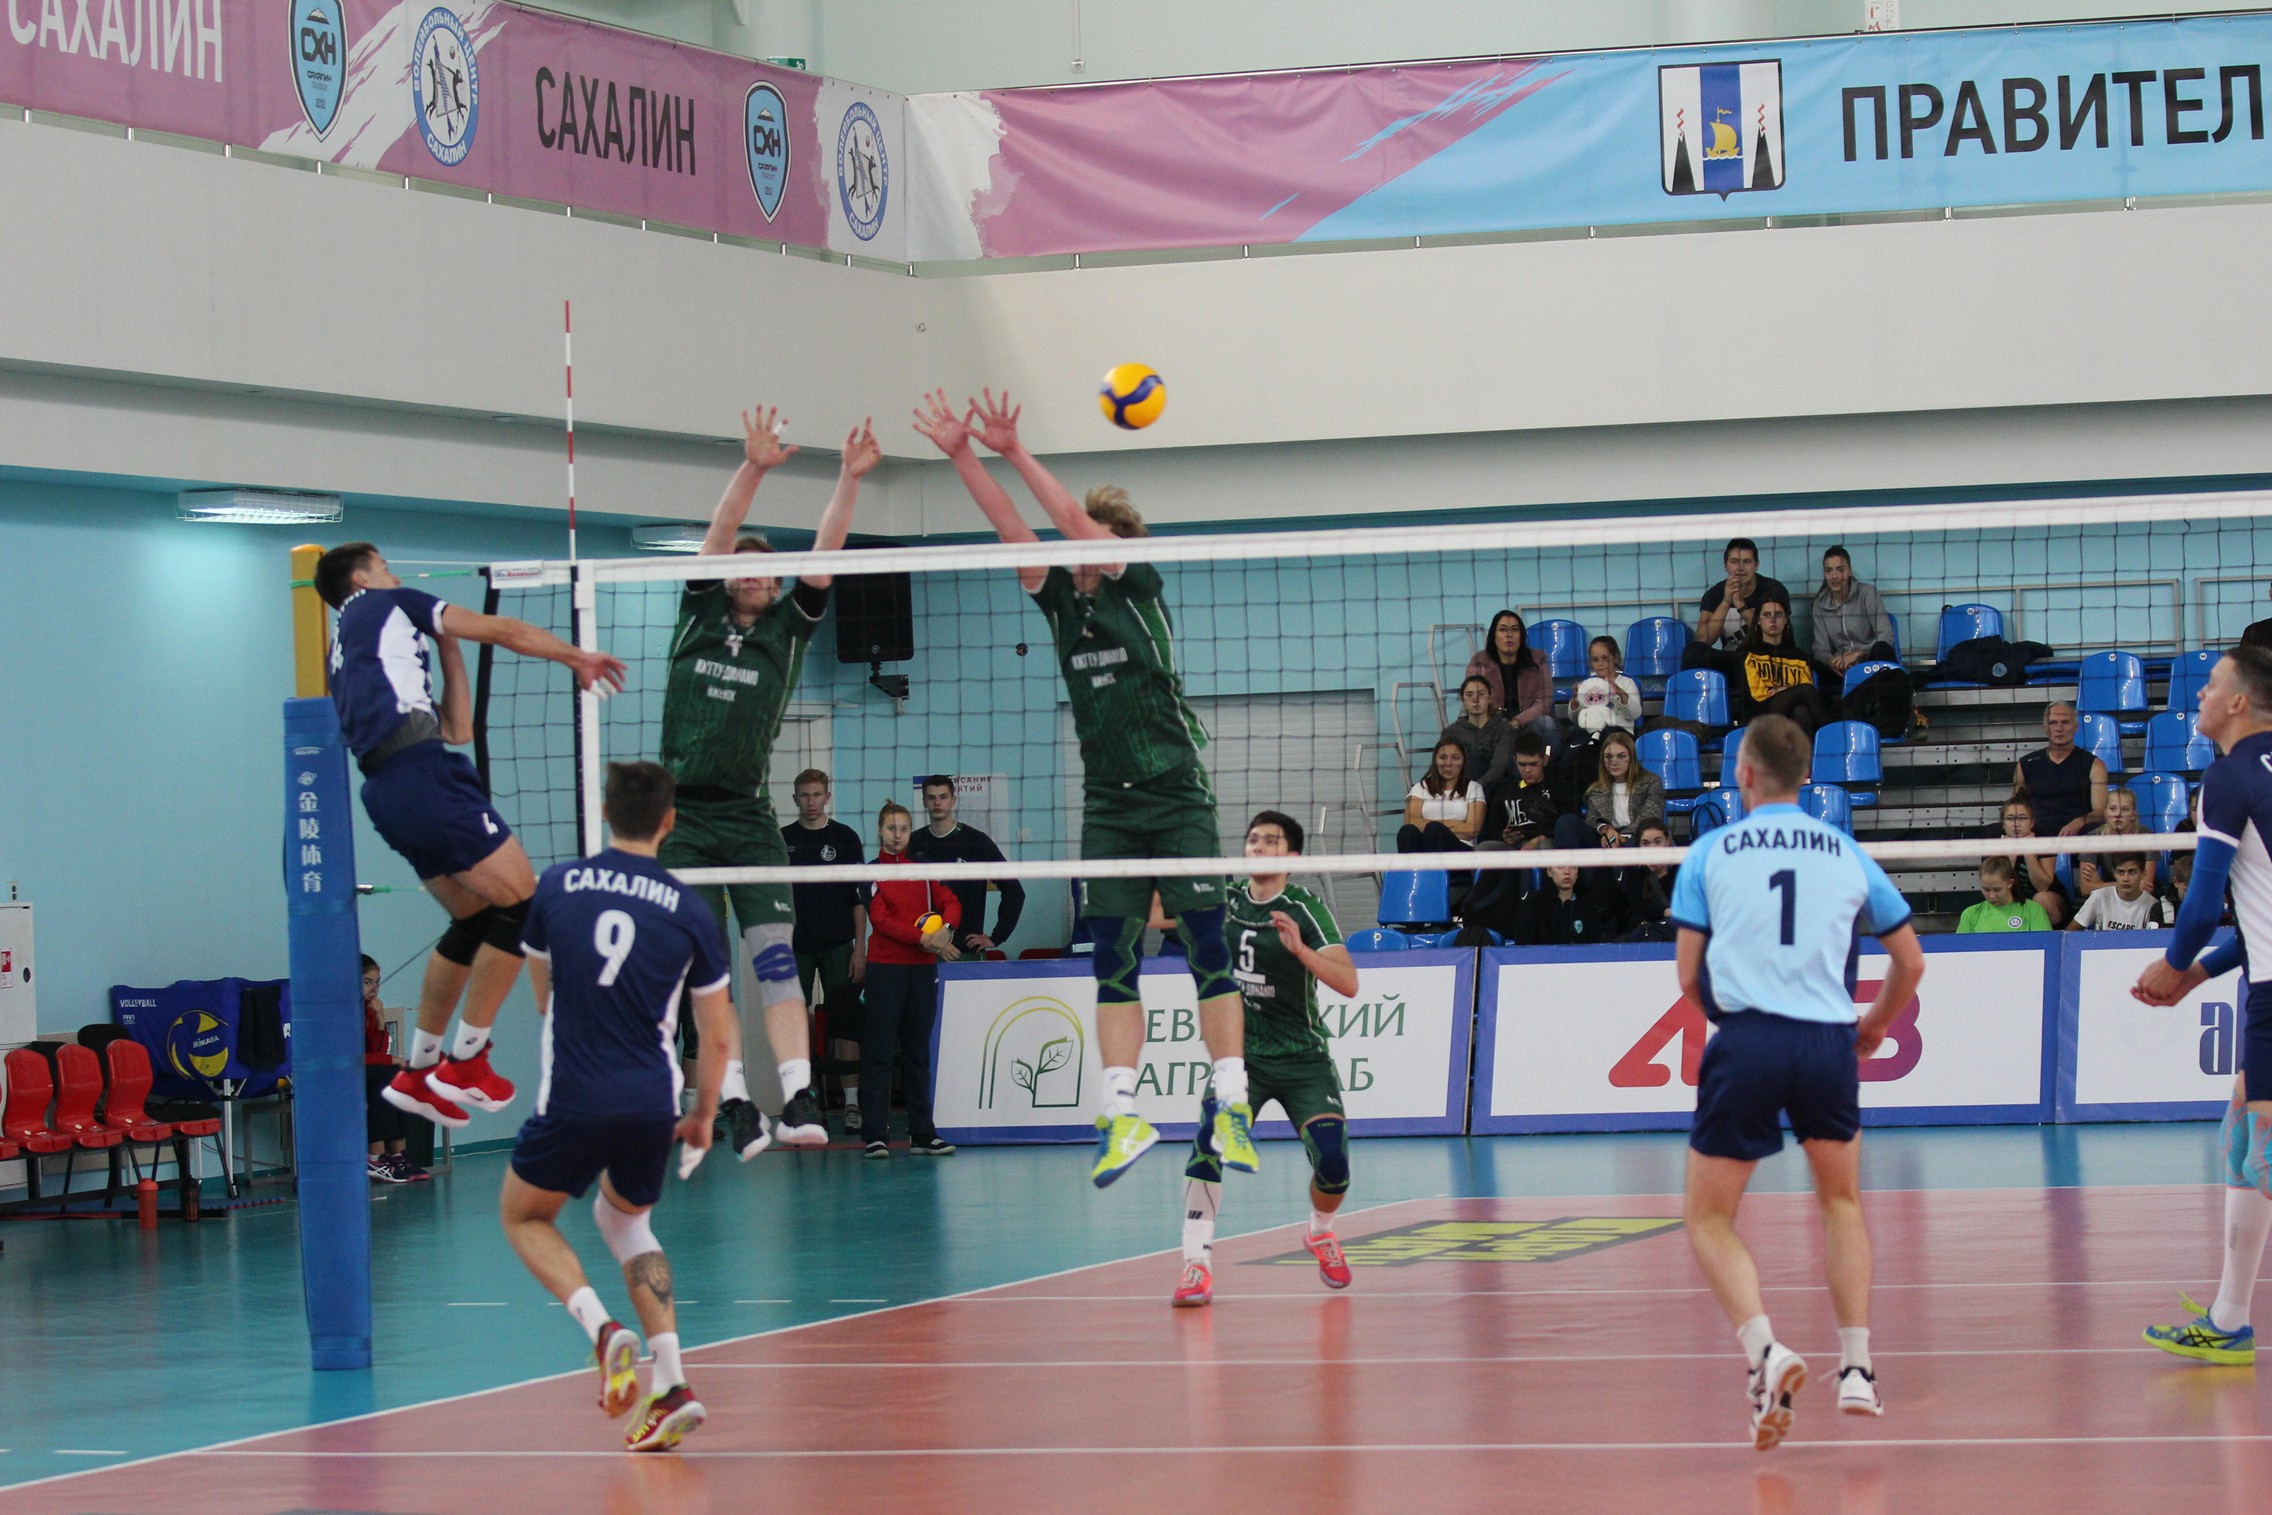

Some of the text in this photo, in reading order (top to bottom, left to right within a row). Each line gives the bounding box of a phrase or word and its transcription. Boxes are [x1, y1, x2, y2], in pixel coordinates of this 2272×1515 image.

[413, 11, 478, 105] ВОЛЕЙБОЛЬНЫЙ ЦЕНТР
[427, 133, 467, 164] САХАЛИН
[536, 66, 696, 176] САХАЛИН
[299, 791, 323, 893] 金陵体育
[1723, 828, 1841, 857] САХАЛИН
[564, 867, 681, 913] САХАЛИН
[1769, 868, 1796, 945] 1
[594, 909, 636, 987] 9
[1239, 929, 1257, 973] 5
[119, 999, 157, 1008] VOLLEYBALL
